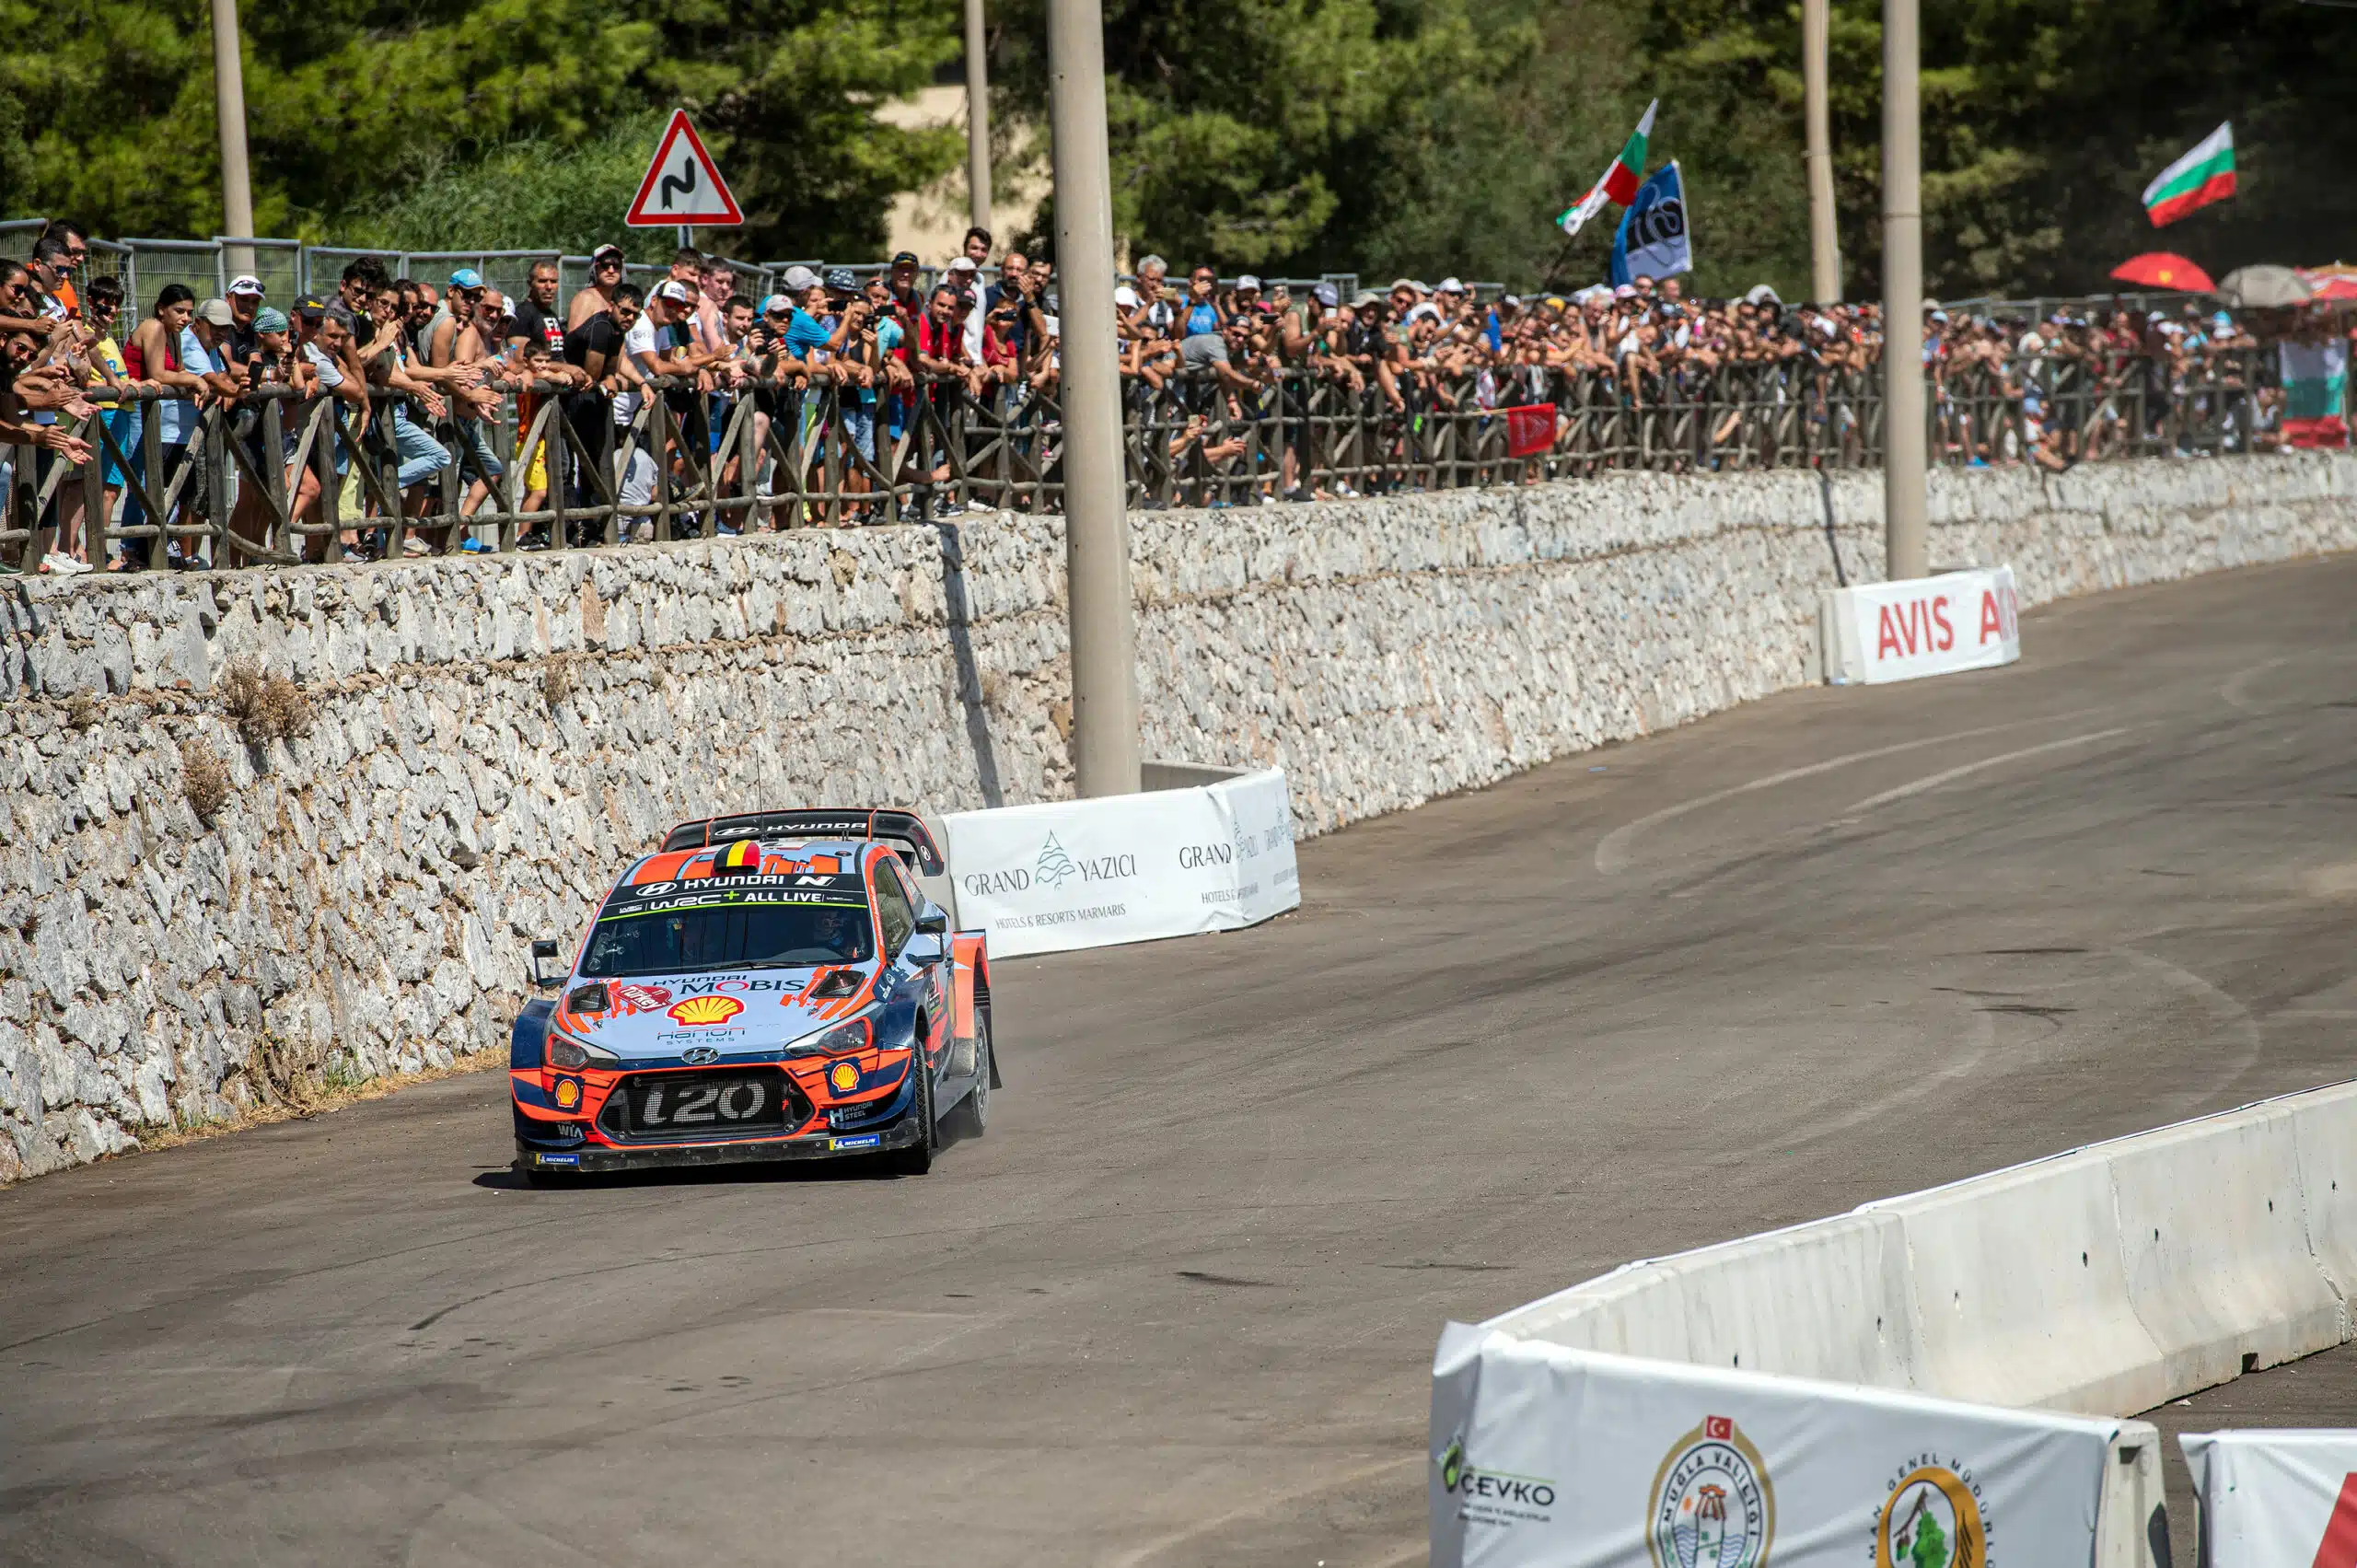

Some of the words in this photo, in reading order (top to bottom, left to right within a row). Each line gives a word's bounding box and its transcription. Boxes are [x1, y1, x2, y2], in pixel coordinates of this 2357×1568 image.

[1877, 596, 1955, 661] AVIS
[767, 822, 868, 831] HYUNDA
[1179, 842, 1232, 869] GRAND
[965, 868, 1030, 896] GRAND
[1077, 854, 1138, 882] YAZICI
[683, 875, 784, 890] HYUNDAI
[744, 892, 779, 902] ALL
[784, 893, 822, 902] LIVE
[995, 916, 1028, 930] HOTELS
[1027, 916, 1034, 927] &
[1035, 910, 1076, 927] RESORTS
[1077, 903, 1127, 921] MARMARIS
[653, 975, 748, 986] HYUNDAI
[680, 980, 806, 994] MOBIS
[667, 1037, 735, 1046] SYSTEMS
[843, 1101, 873, 1113] HYUNDAI
[844, 1110, 866, 1121] STEEL
[844, 1137, 877, 1146] MICHELIN
